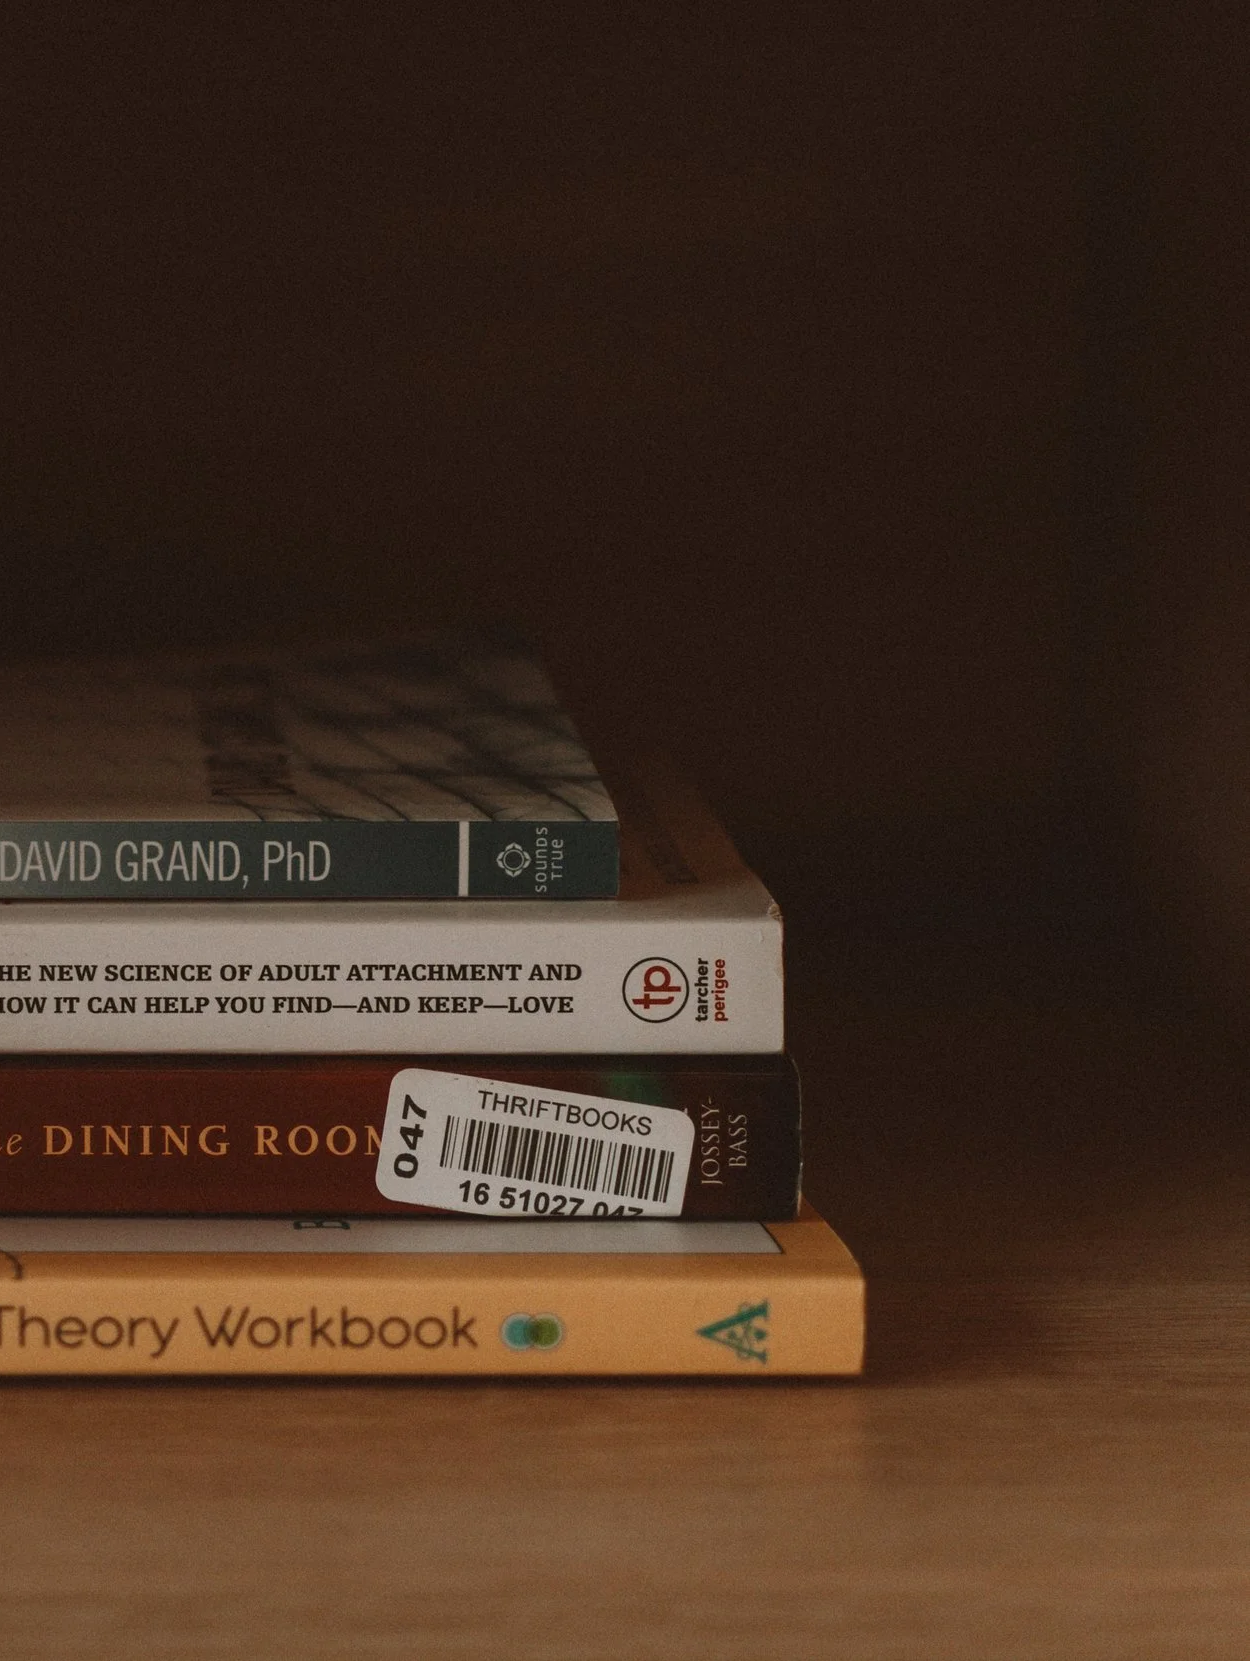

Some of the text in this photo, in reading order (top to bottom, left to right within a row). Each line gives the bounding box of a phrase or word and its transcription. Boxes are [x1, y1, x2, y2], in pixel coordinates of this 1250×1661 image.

[0, 840, 331, 889] DAVID GRAND, PhD
[39, 964, 98, 982] NEW
[104, 964, 213, 983] SCIENCE
[219, 964, 253, 982] OF
[258, 964, 340, 982] ADULT
[346, 964, 523, 982] ATTACHMENT
[527, 964, 583, 982] AND
[694, 957, 709, 1022] tarcher
[711, 958, 729, 1022] perigee
[54, 996, 81, 1015] IT
[86, 996, 138, 1015] CAN
[144, 996, 211, 1015] HELP
[215, 996, 266, 1015] YOU
[393, 1094, 427, 1179] 047
[478, 1090, 652, 1136] THRIFTBOOKS
[43, 1124, 230, 1156] DINING
[700, 1095, 723, 1185] JOSSEY-
[728, 1114, 748, 1168] BASS
[459, 1180, 490, 1205] 16
[499, 1186, 585, 1216] 51027
[195, 1306, 479, 1349] Workbook
